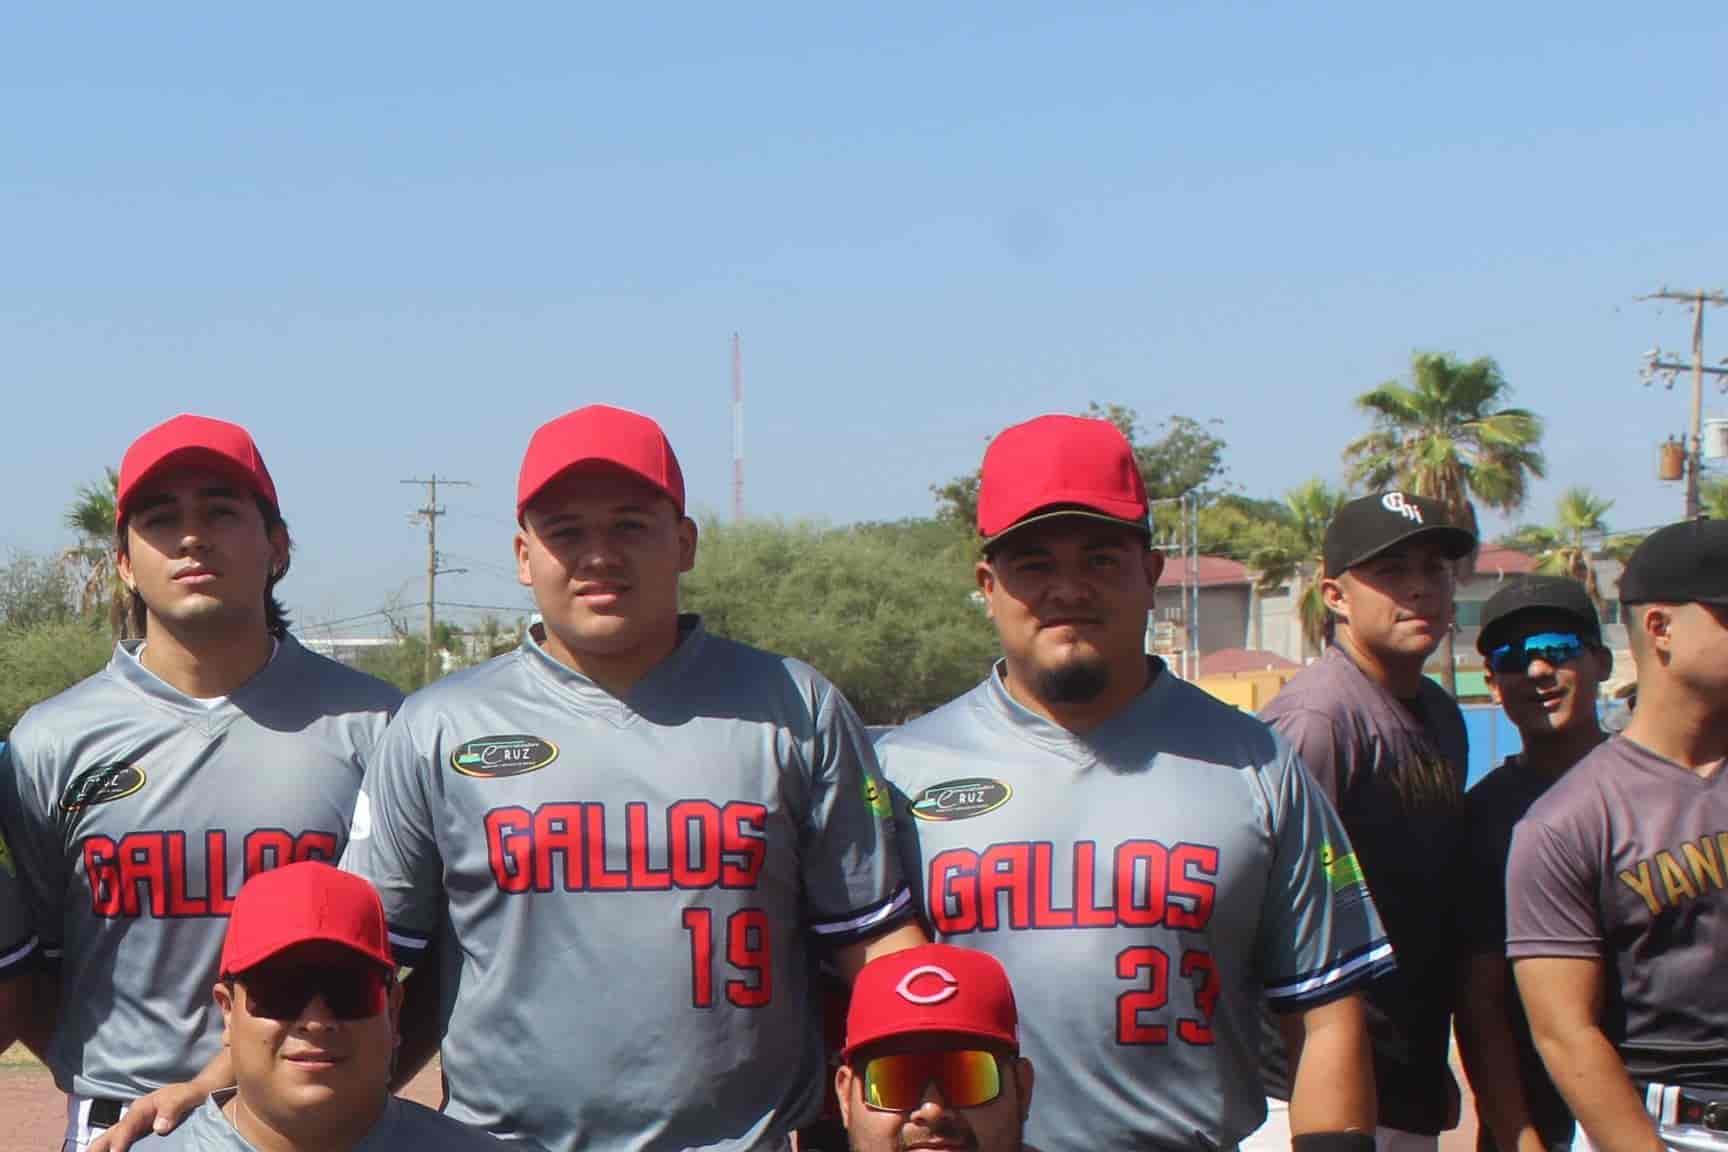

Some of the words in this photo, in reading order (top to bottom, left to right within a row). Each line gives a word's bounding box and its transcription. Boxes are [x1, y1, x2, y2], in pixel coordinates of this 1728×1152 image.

[484, 800, 768, 893] GALLOS
[928, 839, 1218, 934] GALLOS
[683, 908, 772, 1008] 19
[1116, 945, 1221, 1046] 23
